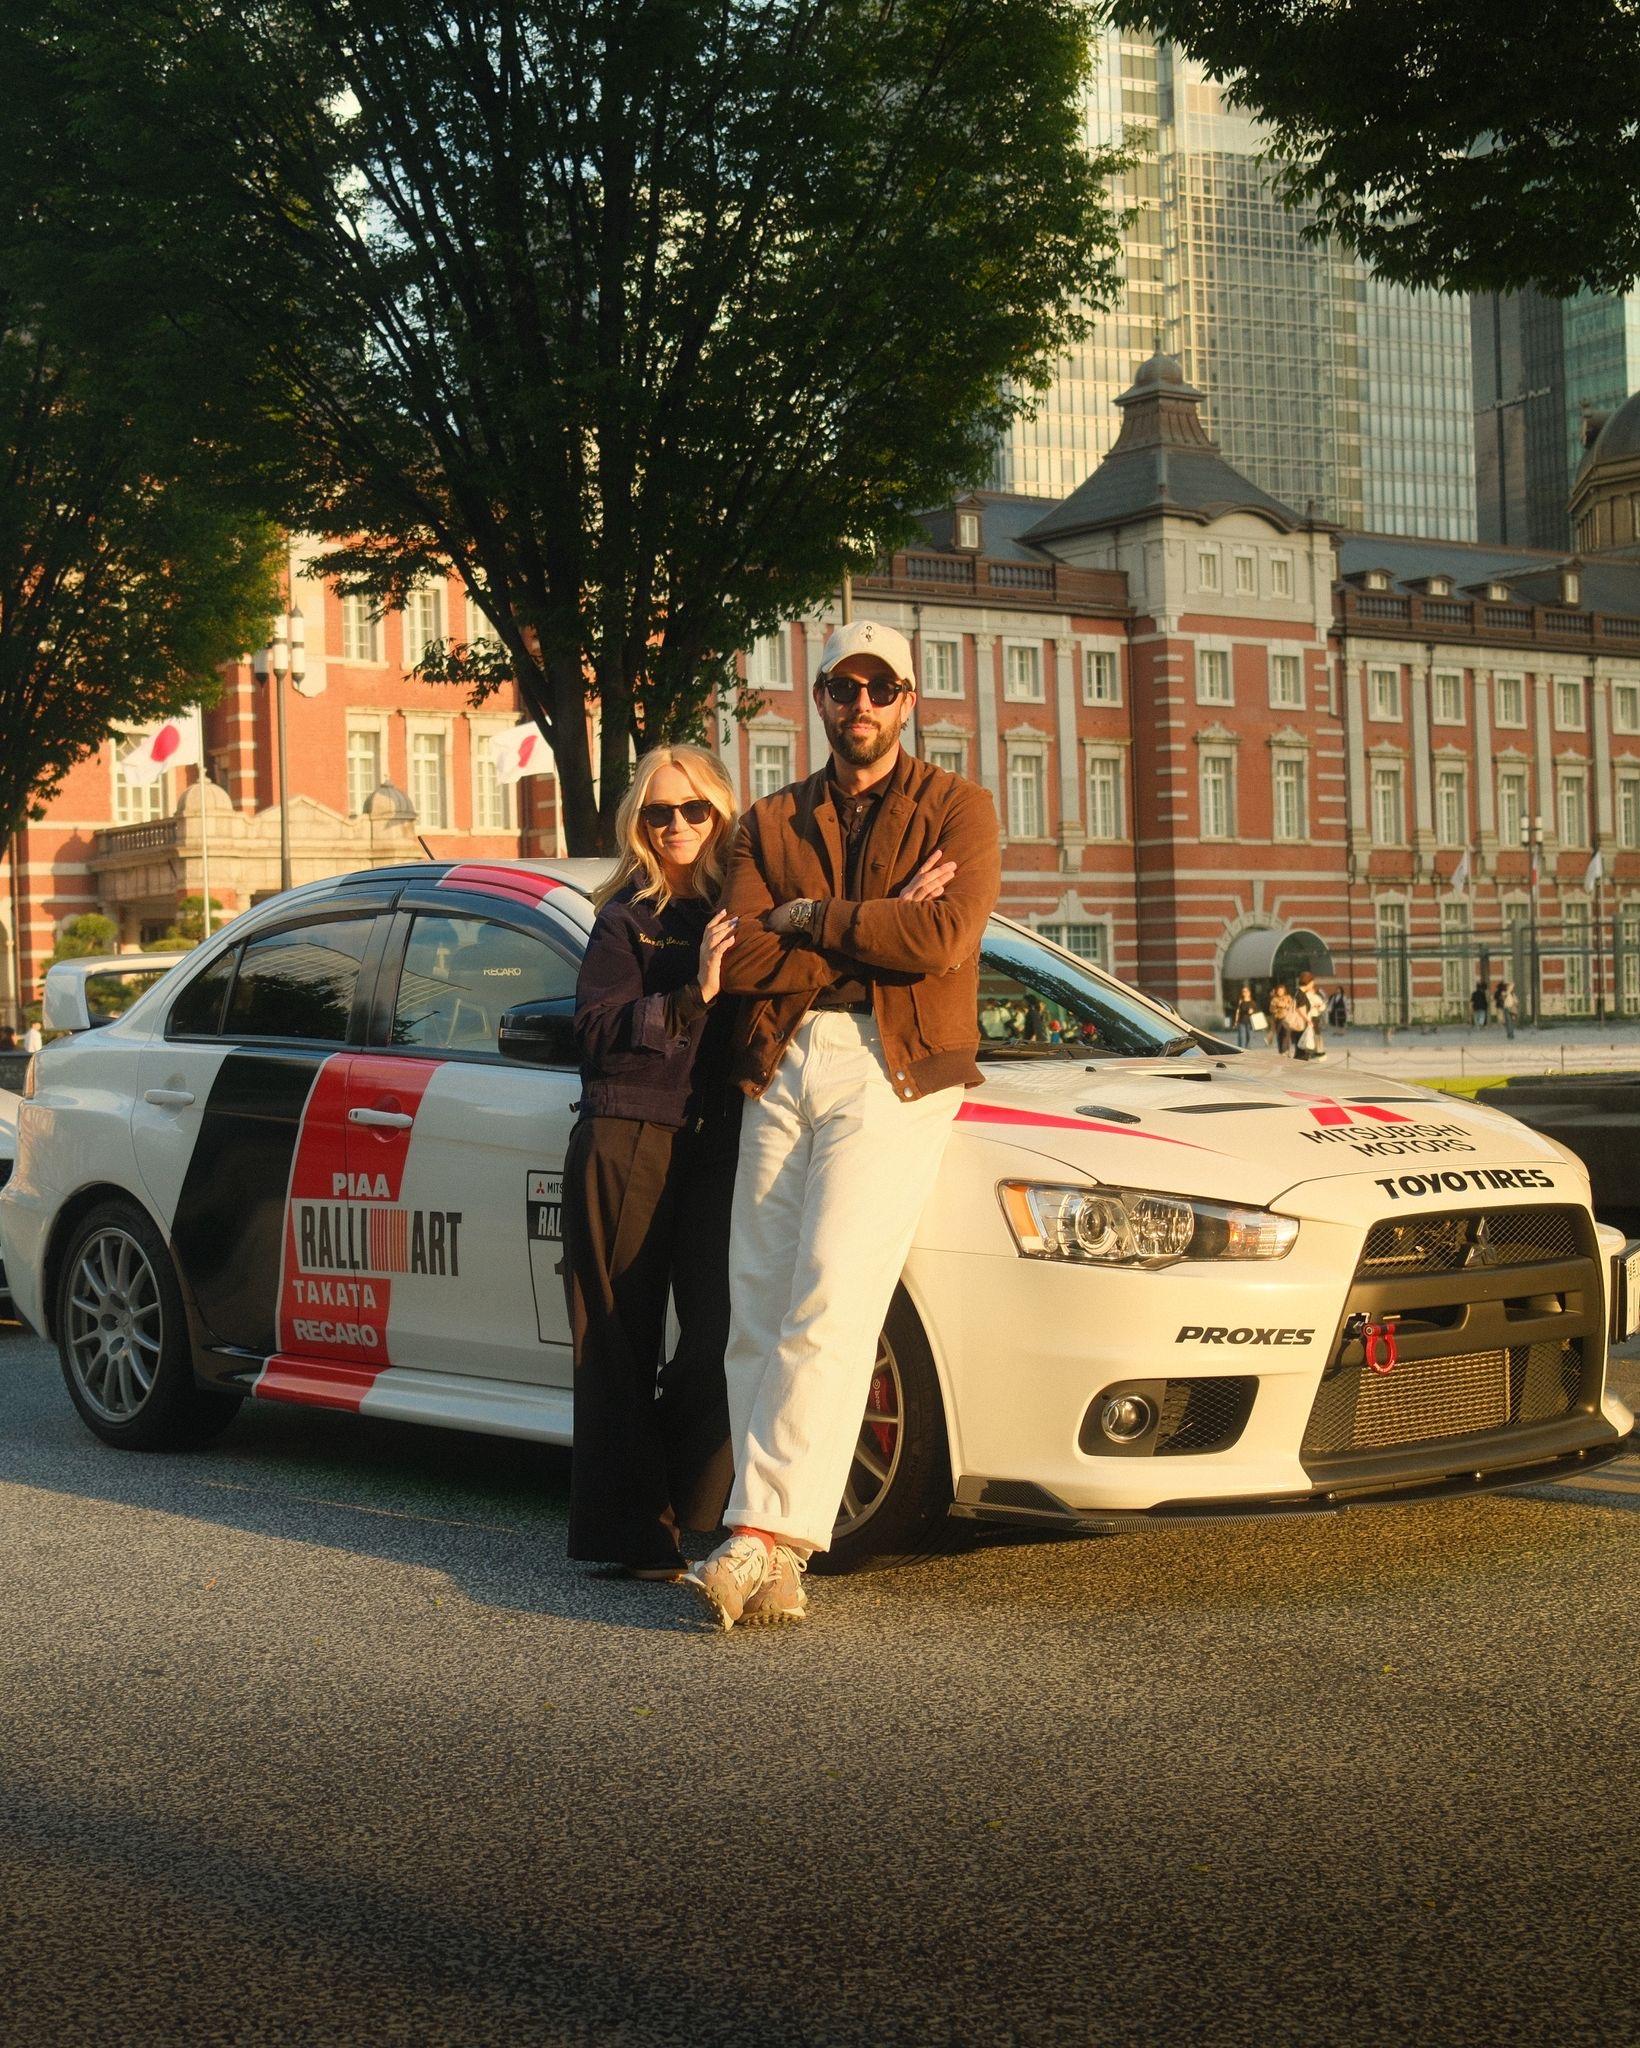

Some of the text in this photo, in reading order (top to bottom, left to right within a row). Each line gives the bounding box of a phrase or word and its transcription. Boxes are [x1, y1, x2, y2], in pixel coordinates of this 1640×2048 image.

[483, 967, 522, 977] RECARO
[1298, 1124, 1472, 1144] MITSUBISHI
[1350, 1139, 1476, 1157] MOTORS
[332, 1172, 391, 1198] PIAA
[293, 1279, 377, 1309] TAKATA
[292, 1318, 379, 1348] RECARO
[1175, 1326, 1315, 1345] PROXES
